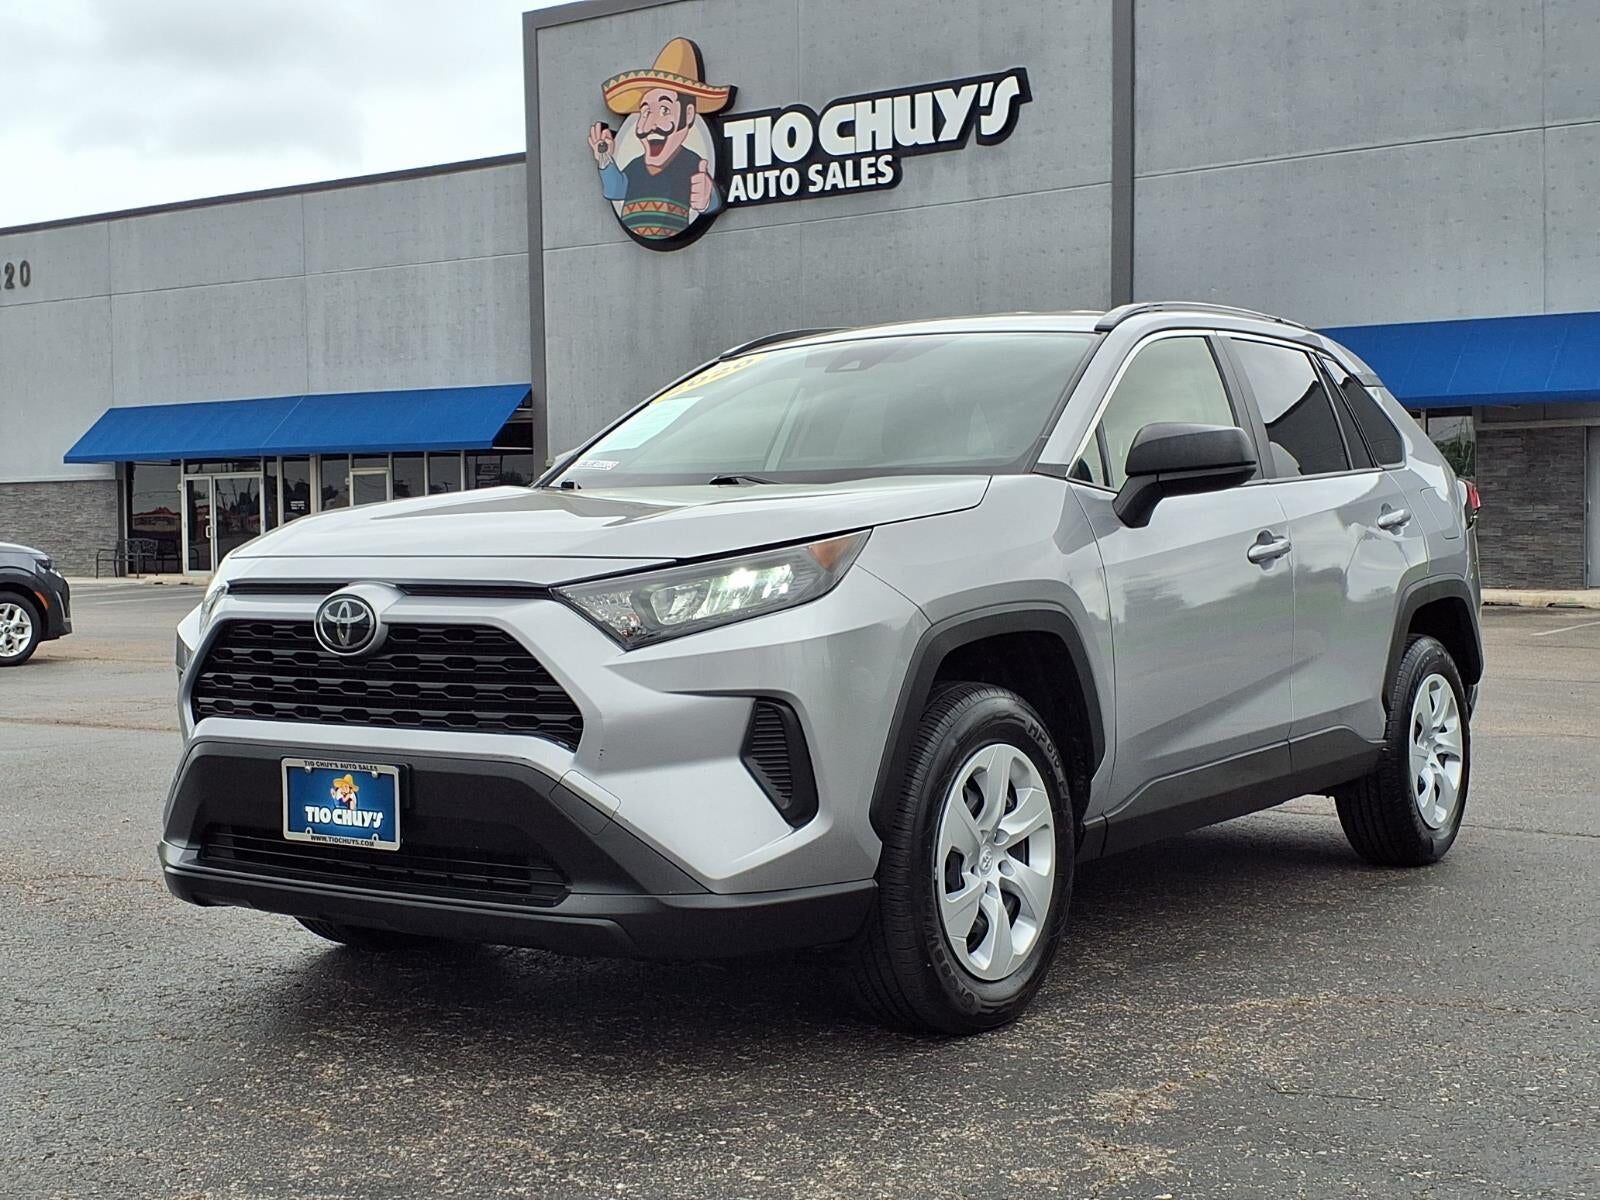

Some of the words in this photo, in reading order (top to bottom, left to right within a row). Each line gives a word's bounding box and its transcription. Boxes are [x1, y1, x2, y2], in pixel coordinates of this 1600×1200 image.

[724, 111, 813, 170] TIO
[818, 76, 1020, 156] CHUY'S
[727, 167, 800, 203] AUTO
[807, 155, 894, 193] SALES
[0, 260, 31, 290] 20
[305, 806, 331, 824] TIO
[332, 808, 384, 828] CHUY'S
